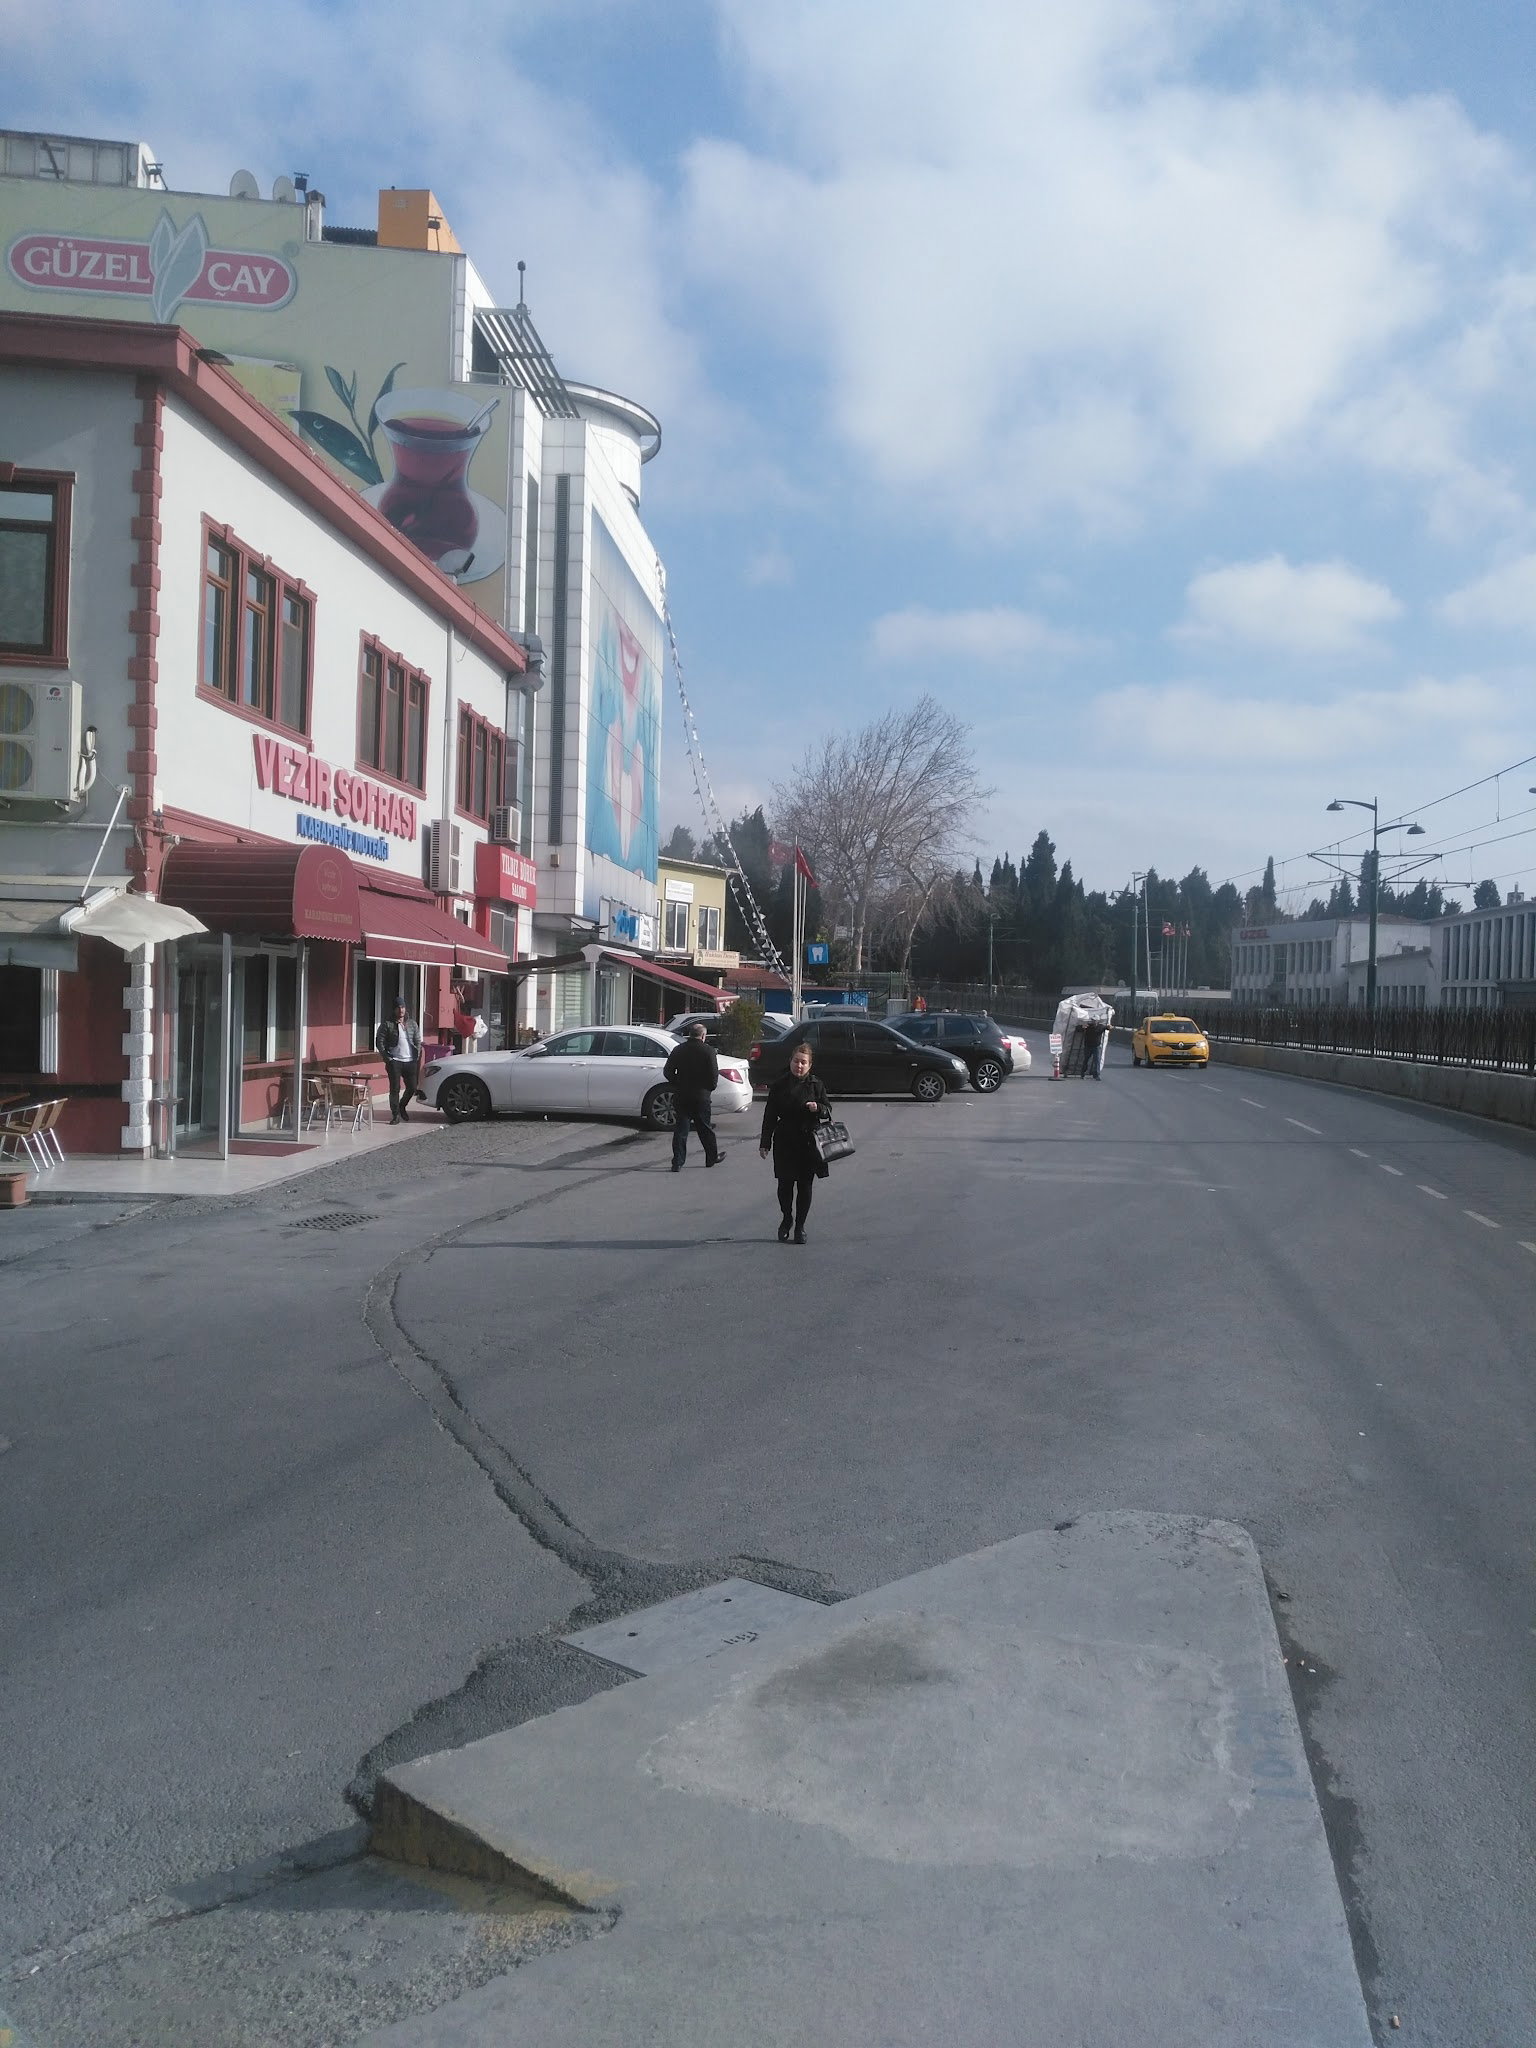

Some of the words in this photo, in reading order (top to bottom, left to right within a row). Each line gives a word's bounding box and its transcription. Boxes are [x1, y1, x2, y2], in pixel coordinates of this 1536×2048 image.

[23, 240, 150, 284] GÜZEL
[207, 262, 276, 297] ÇAY
[334, 769, 417, 842] SOFRASI
[297, 813, 352, 850] KARADENİZ
[353, 831, 389, 862] MUTFAĞI
[502, 853, 519, 879] YILDIZ
[520, 859, 537, 886] BÖREK
[512, 882, 527, 900] SALONU
